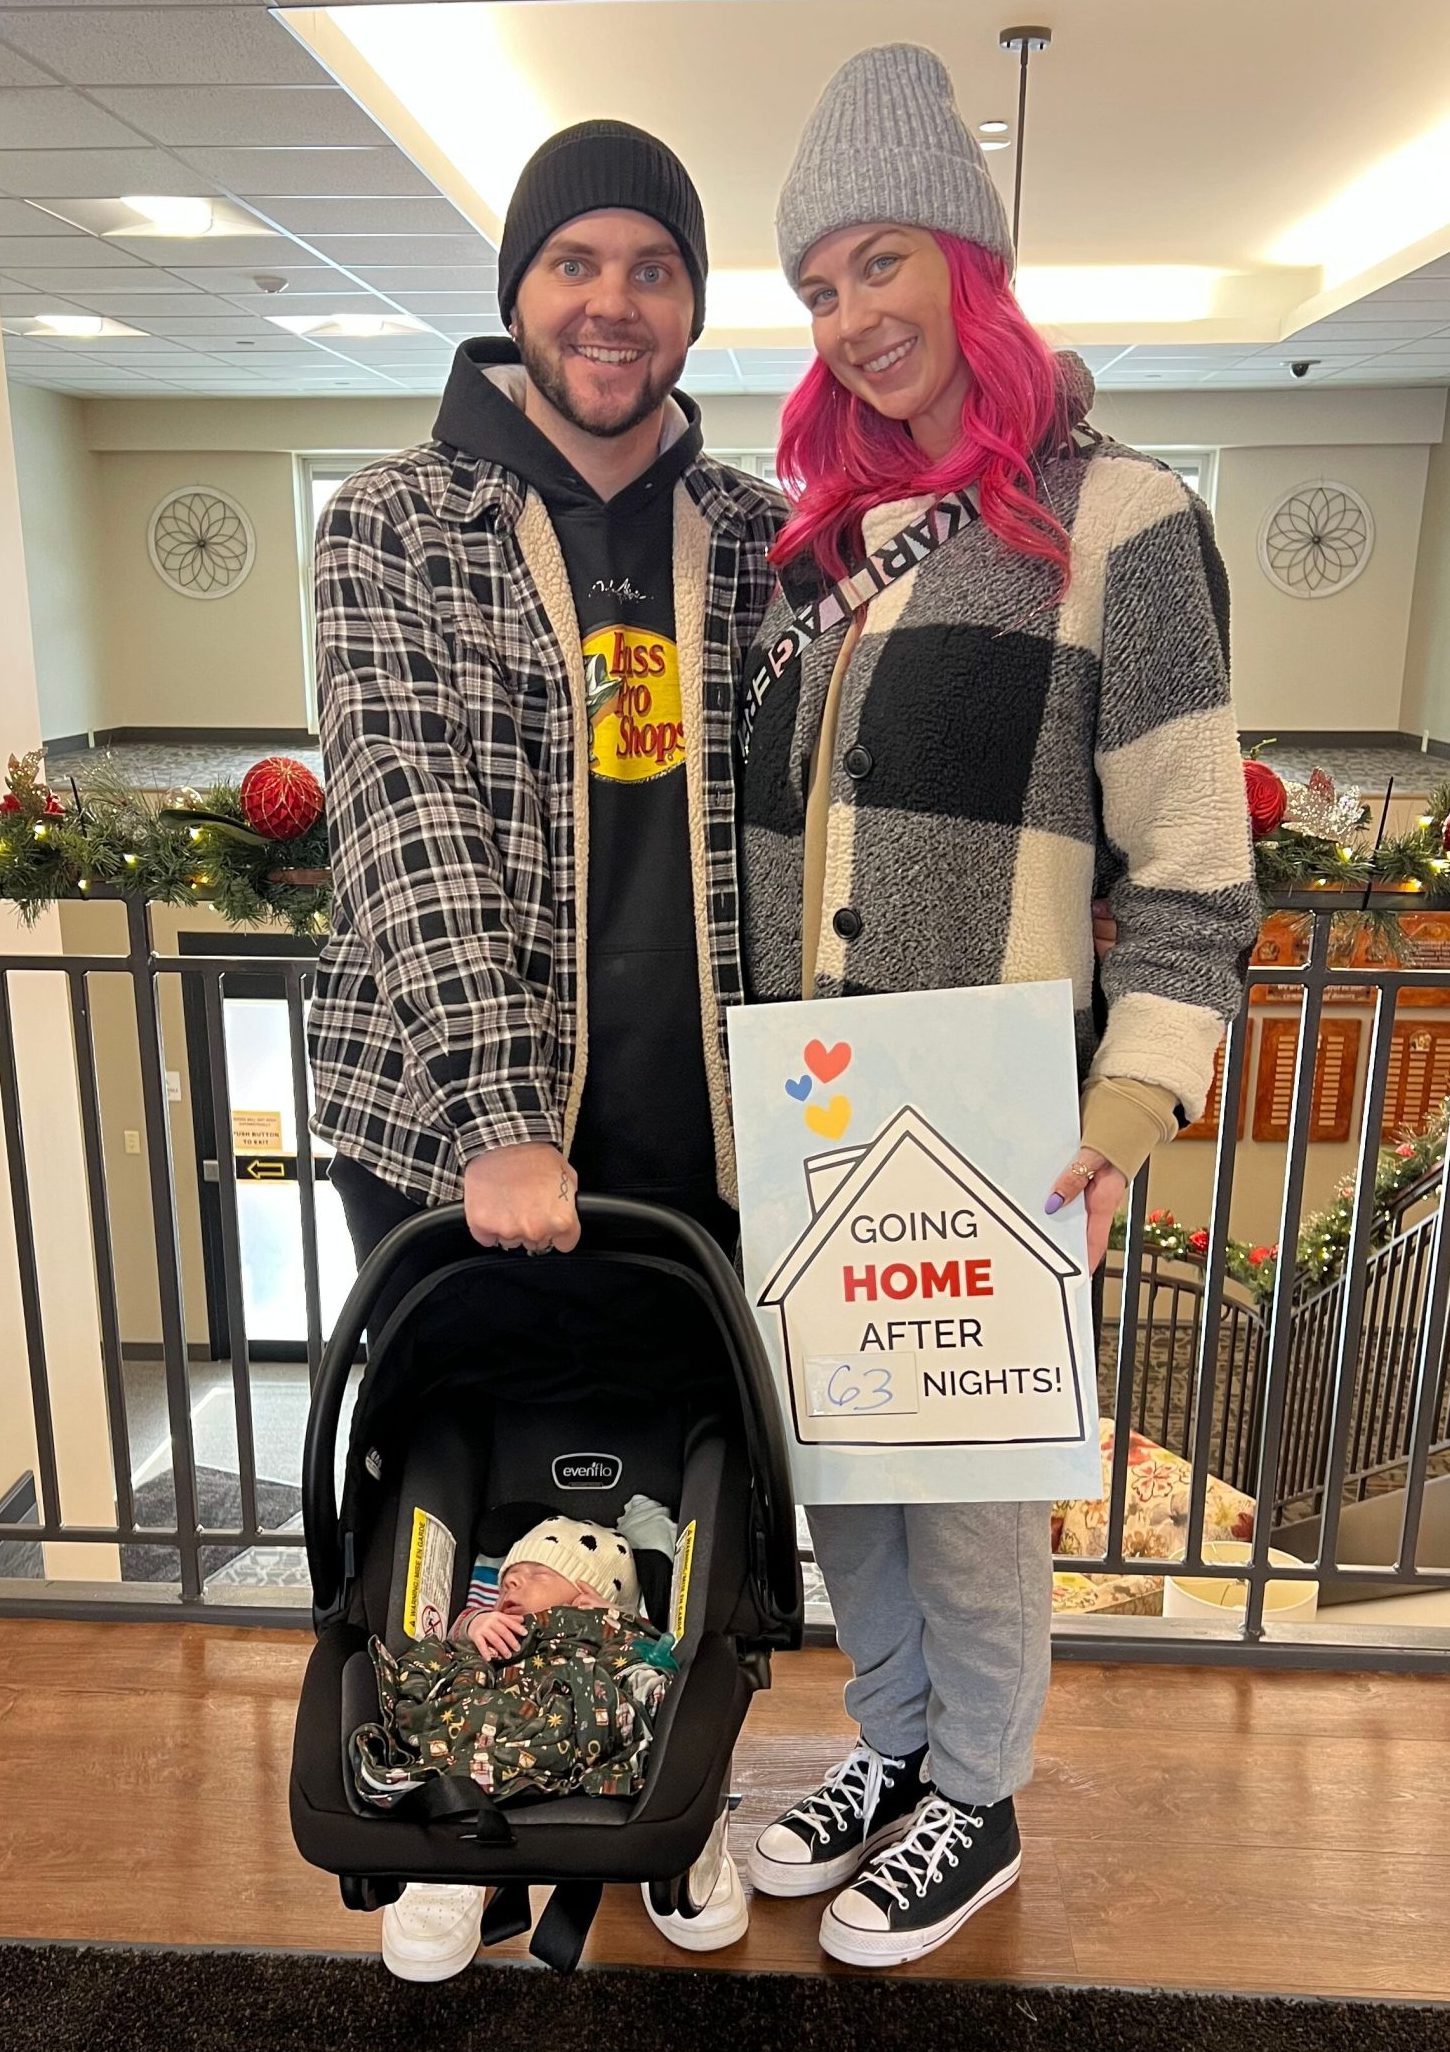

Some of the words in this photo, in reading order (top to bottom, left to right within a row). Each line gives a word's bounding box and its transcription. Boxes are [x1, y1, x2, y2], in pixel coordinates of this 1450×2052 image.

[847, 489, 980, 590] KARL
[850, 1209, 979, 1243] GOING
[843, 1259, 994, 1302] HOME
[859, 1318, 984, 1351] AFTER
[827, 1364, 893, 1411] 63
[923, 1366, 1062, 1397] NIGHTS!
[563, 1462, 612, 1477] evenflo
